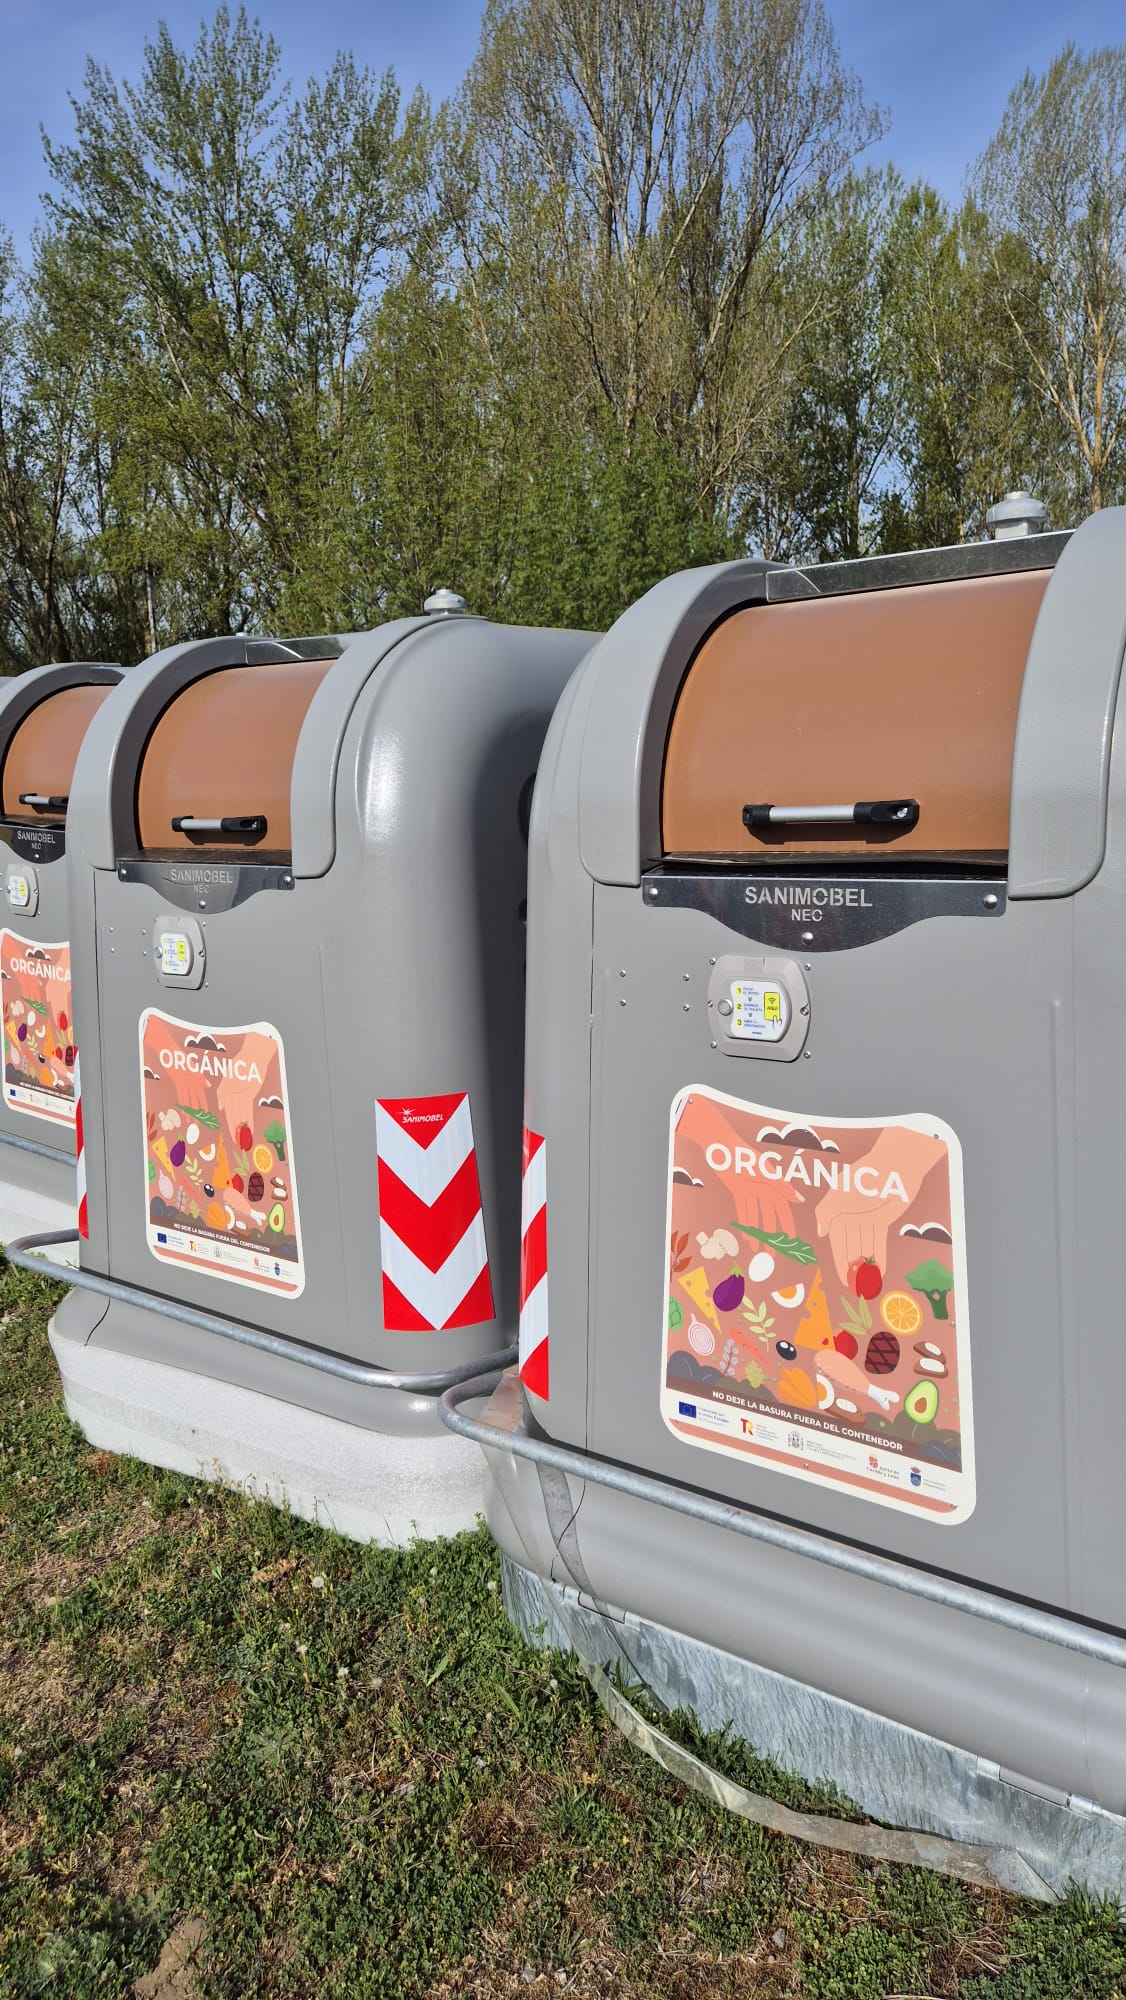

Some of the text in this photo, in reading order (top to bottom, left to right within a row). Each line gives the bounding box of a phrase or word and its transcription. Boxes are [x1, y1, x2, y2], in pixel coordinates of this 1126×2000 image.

[17, 830, 56, 844] SANIMOBEL
[170, 868, 233, 884] SANIMOBEL
[745, 886, 873, 907] SANIMOBEL
[791, 908, 823, 922] NEO
[159, 1048, 263, 1084] ORGÁNICA
[402, 1113, 444, 1124] SANIMOBEL
[705, 1143, 910, 1203] ORGÁNICA
[712, 1390, 725, 1400] NO
[726, 1394, 746, 1406] DEJE
[747, 1400, 758, 1410] LA
[759, 1404, 792, 1420] BASURA
[793, 1413, 822, 1428] FUERA
[823, 1422, 840, 1434] DEL
[841, 1427, 904, 1452] CONTENEDOR
